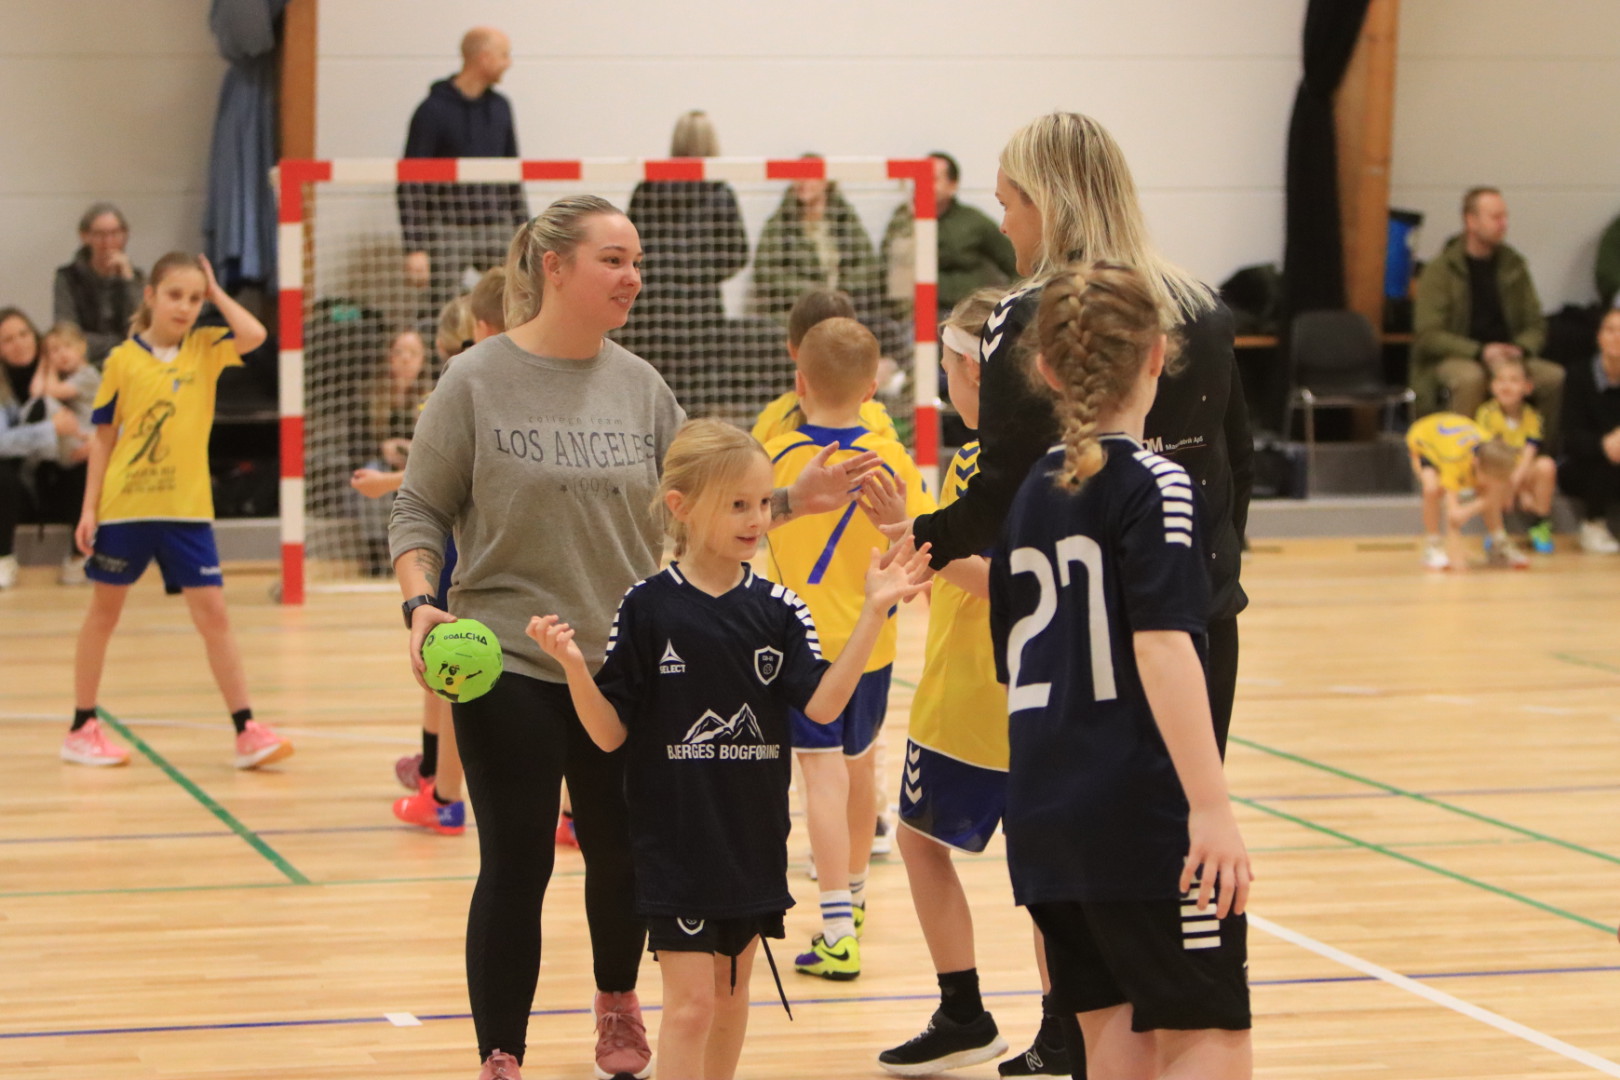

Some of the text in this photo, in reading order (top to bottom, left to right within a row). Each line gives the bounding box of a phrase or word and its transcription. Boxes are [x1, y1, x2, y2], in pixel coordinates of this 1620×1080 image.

[494, 429, 655, 468] LOS ANGELES
[1006, 534, 1118, 716] 27
[659, 664, 686, 674] SELECT
[667, 744, 780, 760] BJERGES BOGFØRING
